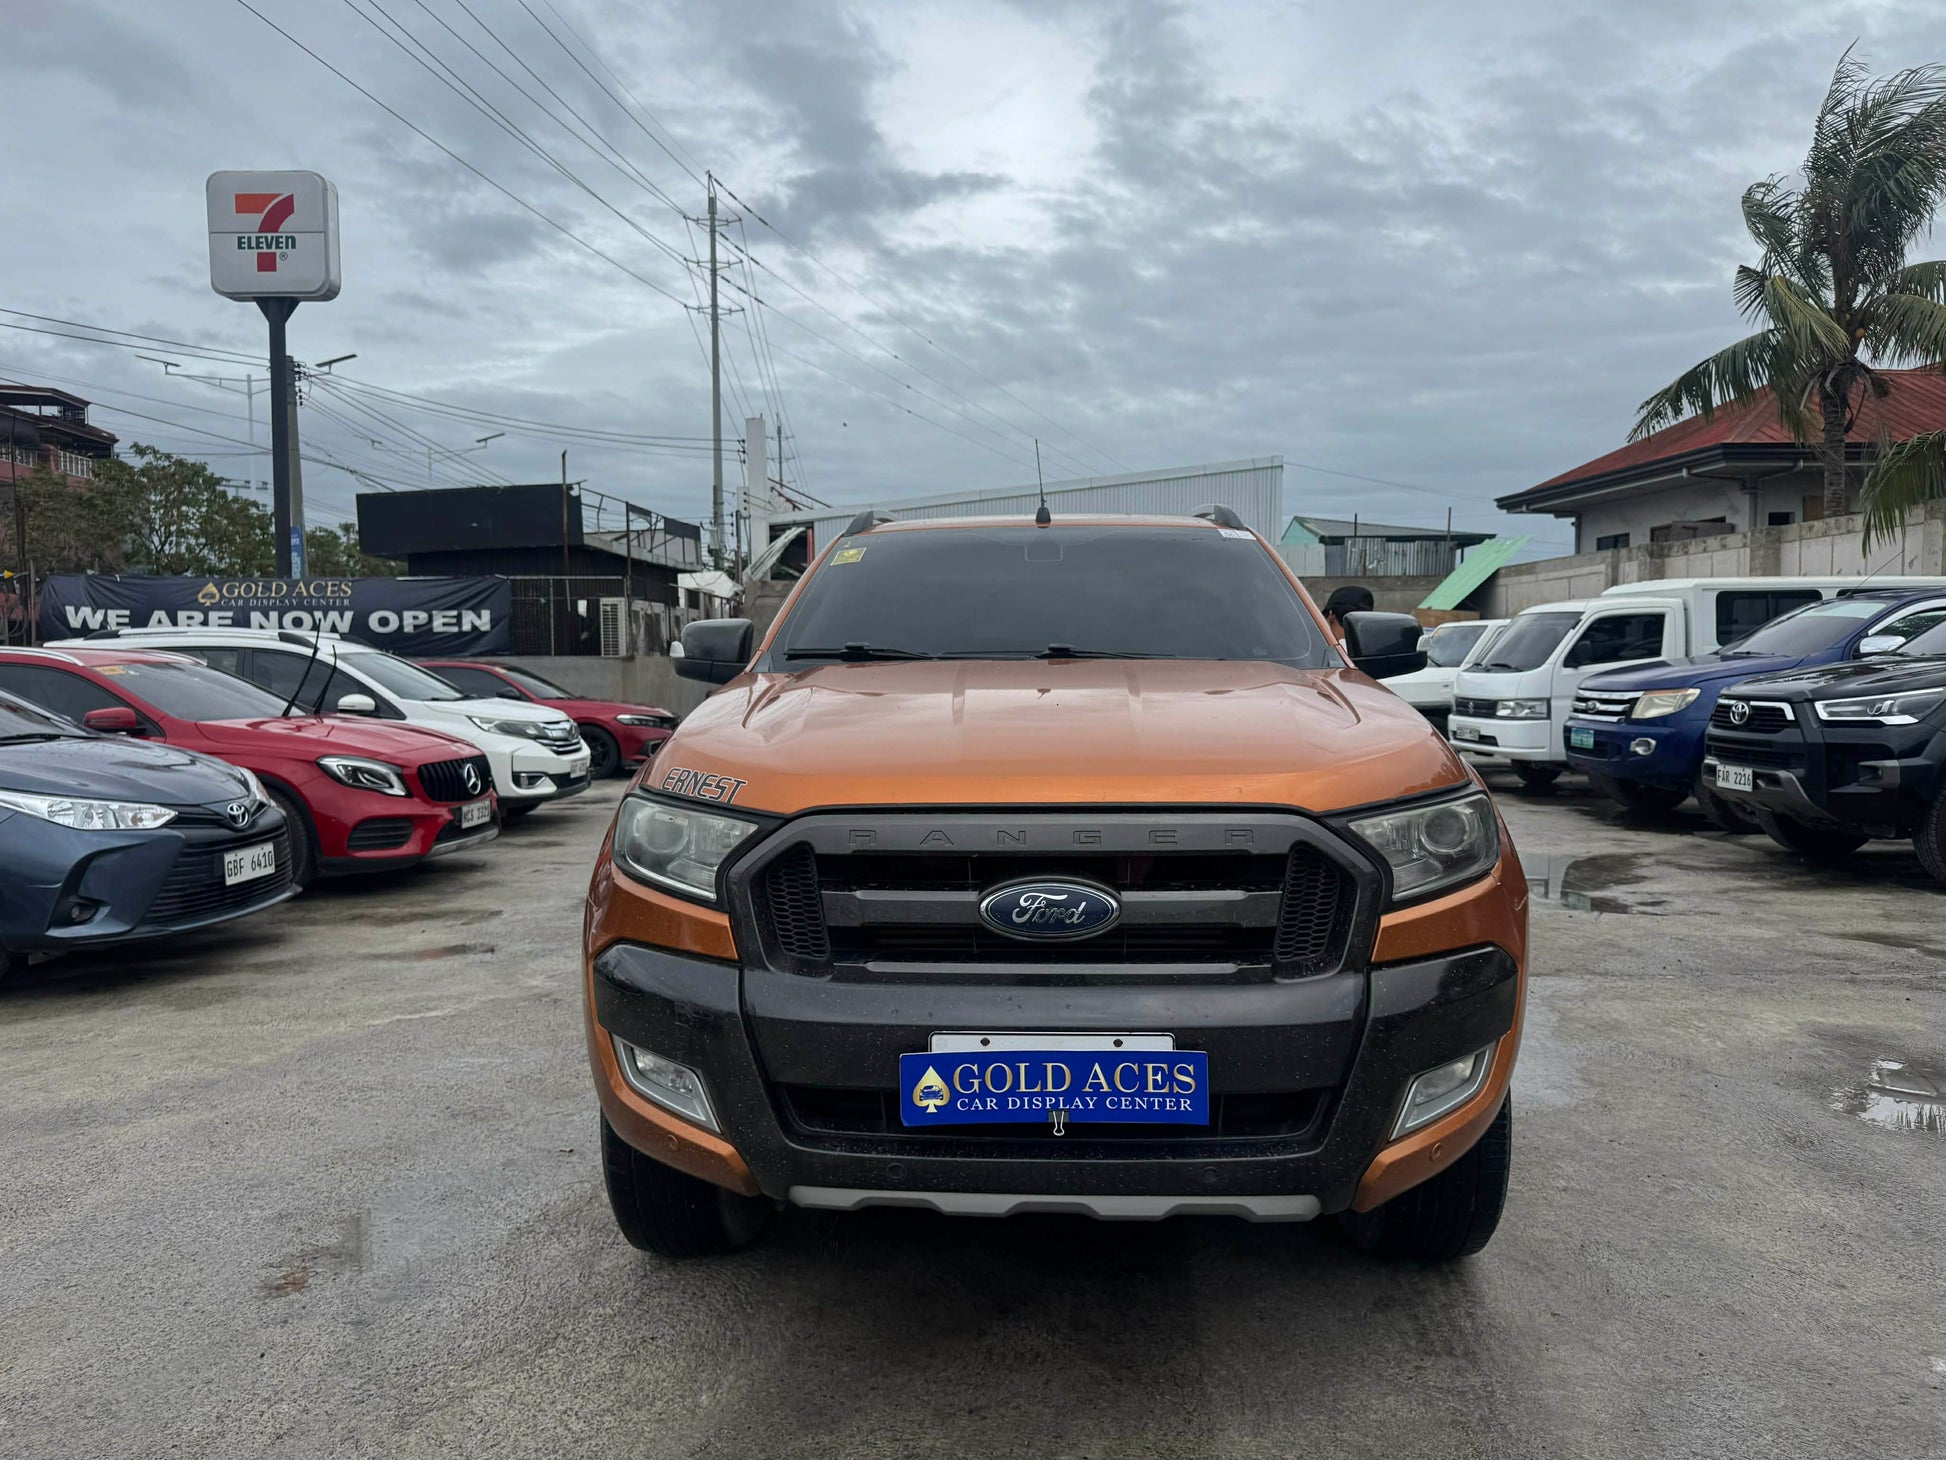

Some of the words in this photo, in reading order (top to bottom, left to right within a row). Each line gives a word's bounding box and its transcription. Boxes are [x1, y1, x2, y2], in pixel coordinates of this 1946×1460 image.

[222, 581, 288, 598] GOLD
[293, 580, 352, 598] ACES
[221, 599, 244, 607] CAR
[250, 599, 299, 607] DISPLAY
[304, 598, 350, 607] CENTER
[64, 605, 131, 630] WE
[147, 610, 234, 628] ARE
[251, 610, 354, 634] NOW
[368, 609, 491, 633] OPEN
[661, 766, 748, 805] ERNEST
[1717, 769, 1730, 783] FAR
[1733, 771, 1752, 787] 2216
[847, 829, 1254, 846] RANGER
[226, 857, 244, 878] GBF
[251, 850, 274, 872] 6410
[1011, 892, 1087, 924] Ford
[952, 1062, 1072, 1095] GOLD
[1082, 1062, 1197, 1094] ACES
[956, 1097, 999, 1111] CAR
[1007, 1096, 1098, 1110] DISPLAY
[1105, 1096, 1193, 1111] CENTER
